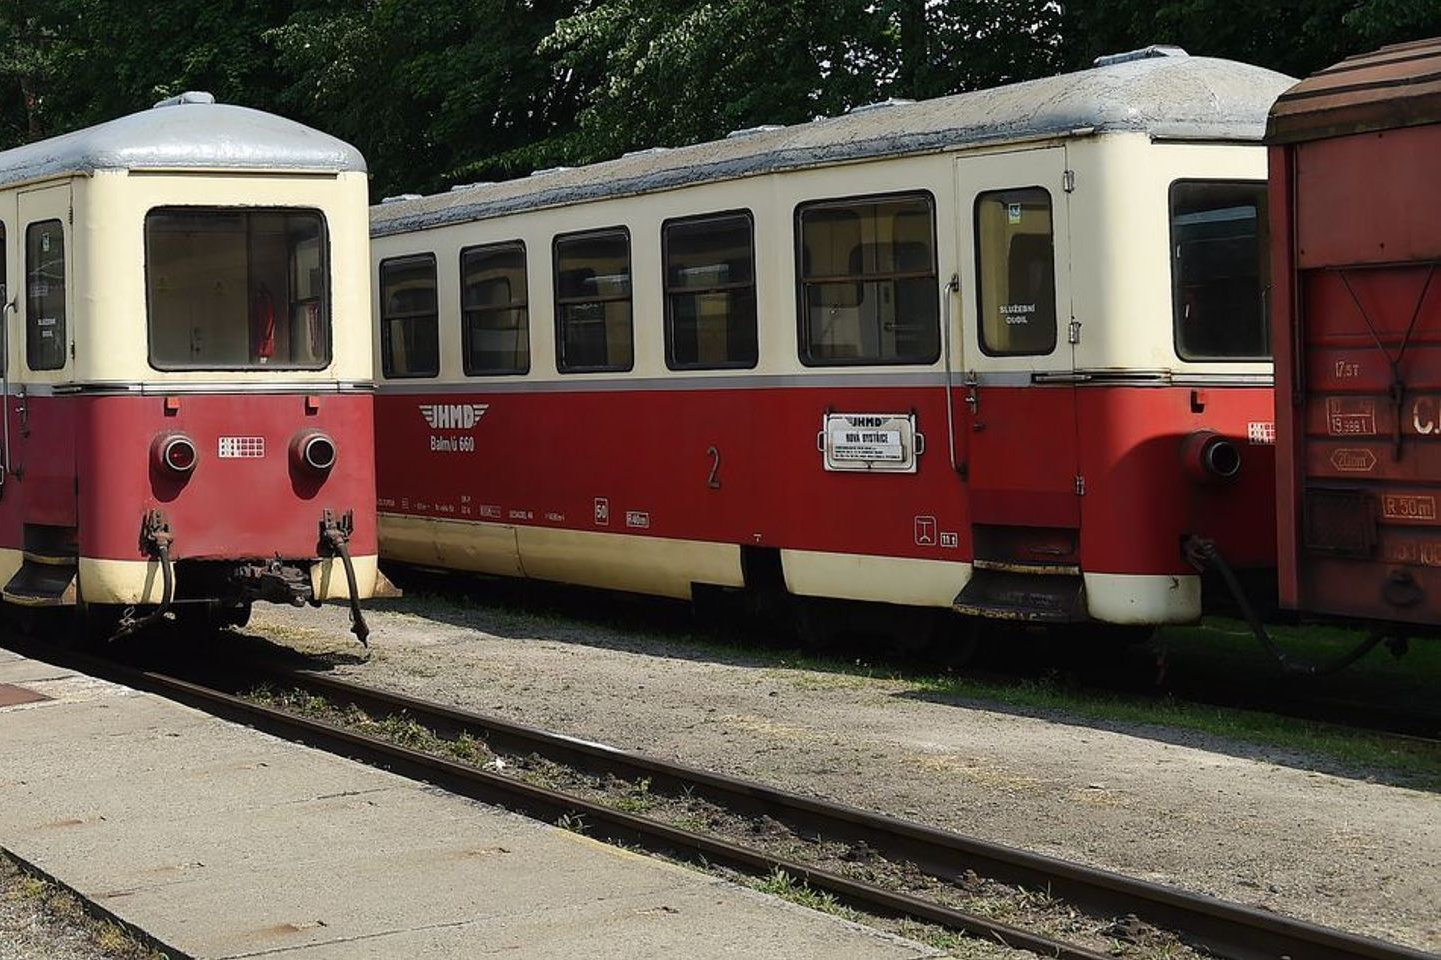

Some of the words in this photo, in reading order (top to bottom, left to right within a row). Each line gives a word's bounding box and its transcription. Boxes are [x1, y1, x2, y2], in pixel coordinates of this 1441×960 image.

[429, 404, 475, 429] JHMD
[852, 417, 882, 427] JHMD
[707, 446, 720, 489] 2
